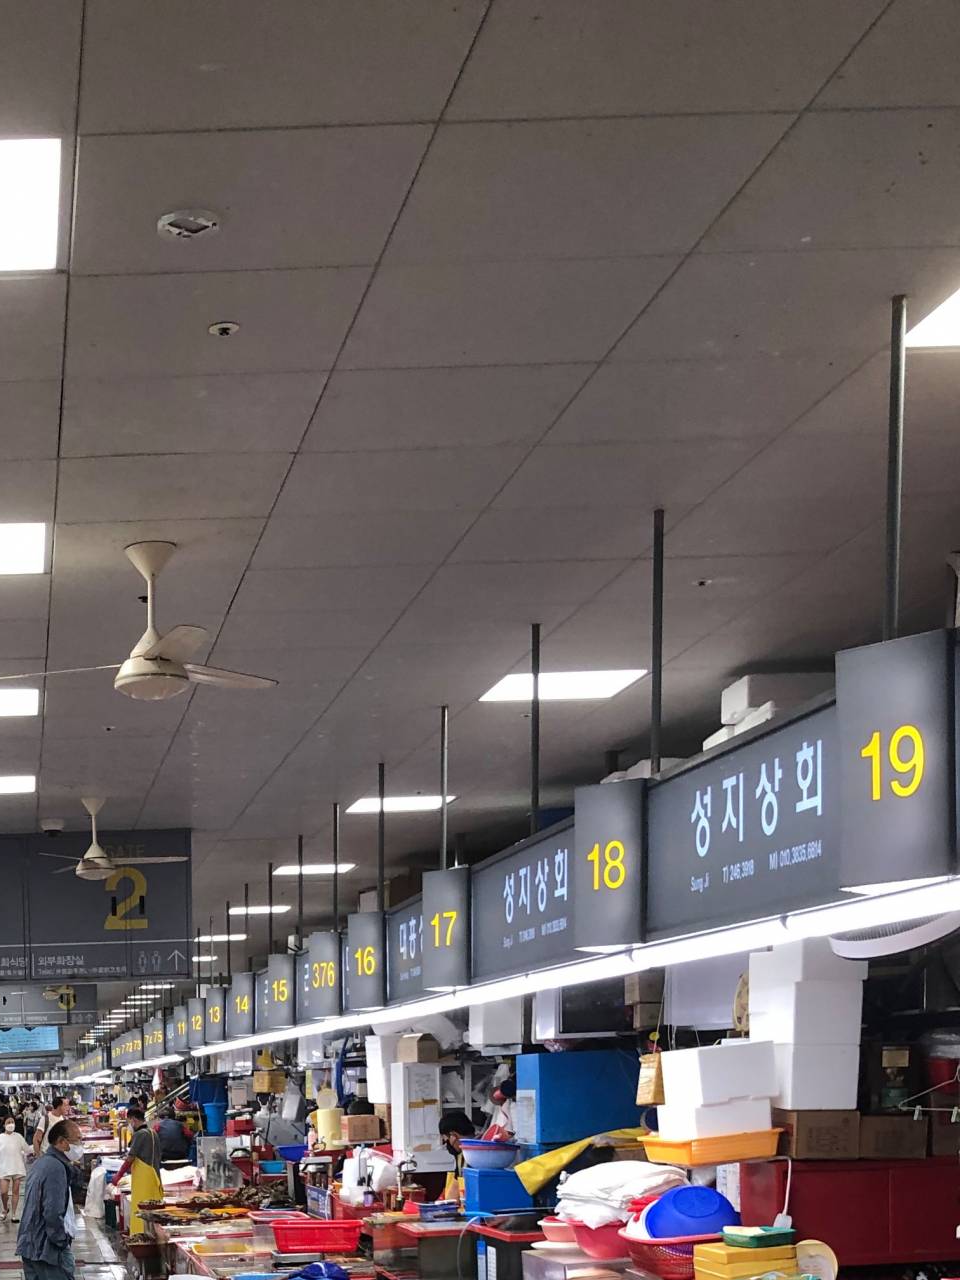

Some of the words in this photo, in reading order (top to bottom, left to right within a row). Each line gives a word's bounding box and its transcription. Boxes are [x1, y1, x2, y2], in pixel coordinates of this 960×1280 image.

[860, 724, 925, 801] 19
[690, 739, 823, 858] 성지상회
[587, 840, 626, 890] 18
[104, 866, 148, 930] 2
[503, 849, 569, 924] 성지상회
[430, 911, 458, 947] 17
[312, 962, 335, 988] 376
[355, 947, 376, 975] 16
[272, 980, 288, 1001] 15
[209, 1007, 220, 1023] 13
[235, 996, 248, 1014] 14
[177, 1022, 185, 1036] 11
[191, 1015, 202, 1030] 12
